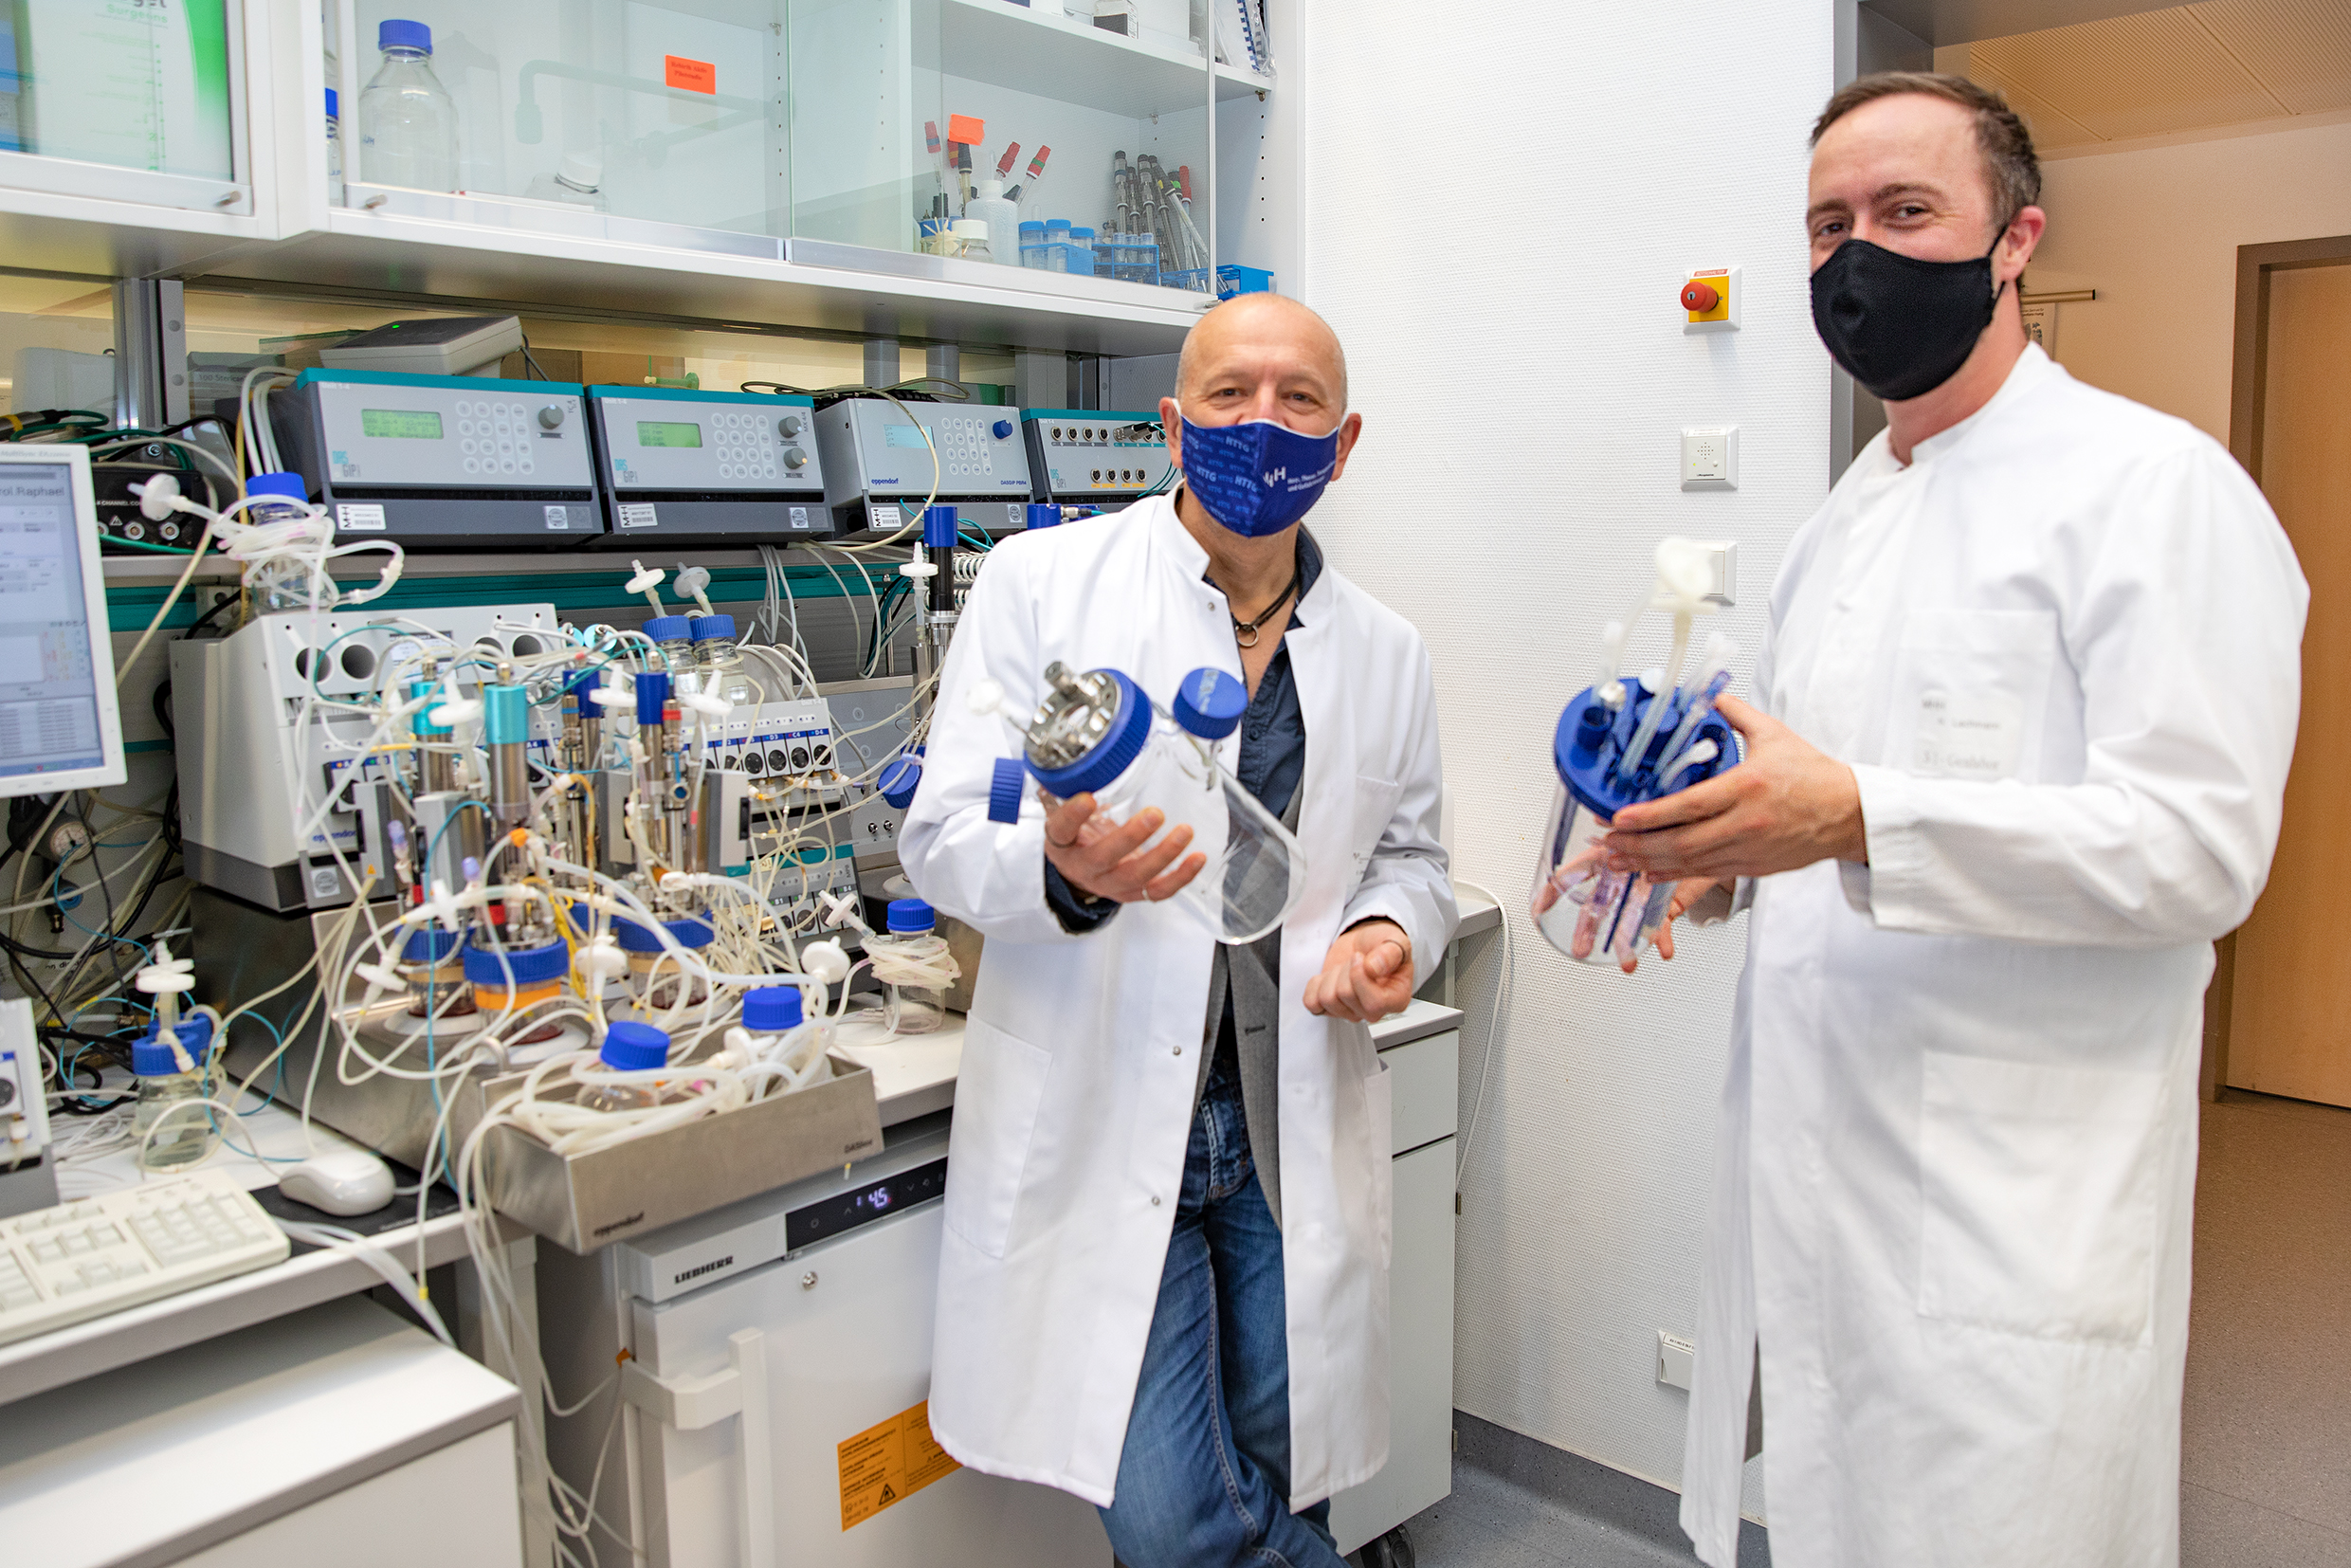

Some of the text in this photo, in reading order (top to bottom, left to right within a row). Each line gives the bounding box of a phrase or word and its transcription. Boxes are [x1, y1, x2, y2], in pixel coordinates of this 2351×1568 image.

[106, 4, 168, 24] Surgeons
[1195, 465, 1217, 483] HTTG
[870, 477, 900, 485] eppendorf
[16, 485, 65, 500] Raphael
[769, 733, 780, 741] D3
[791, 730, 802, 739] C4
[814, 728, 825, 738] D4
[675, 1255, 734, 1285] LIEBHERR
